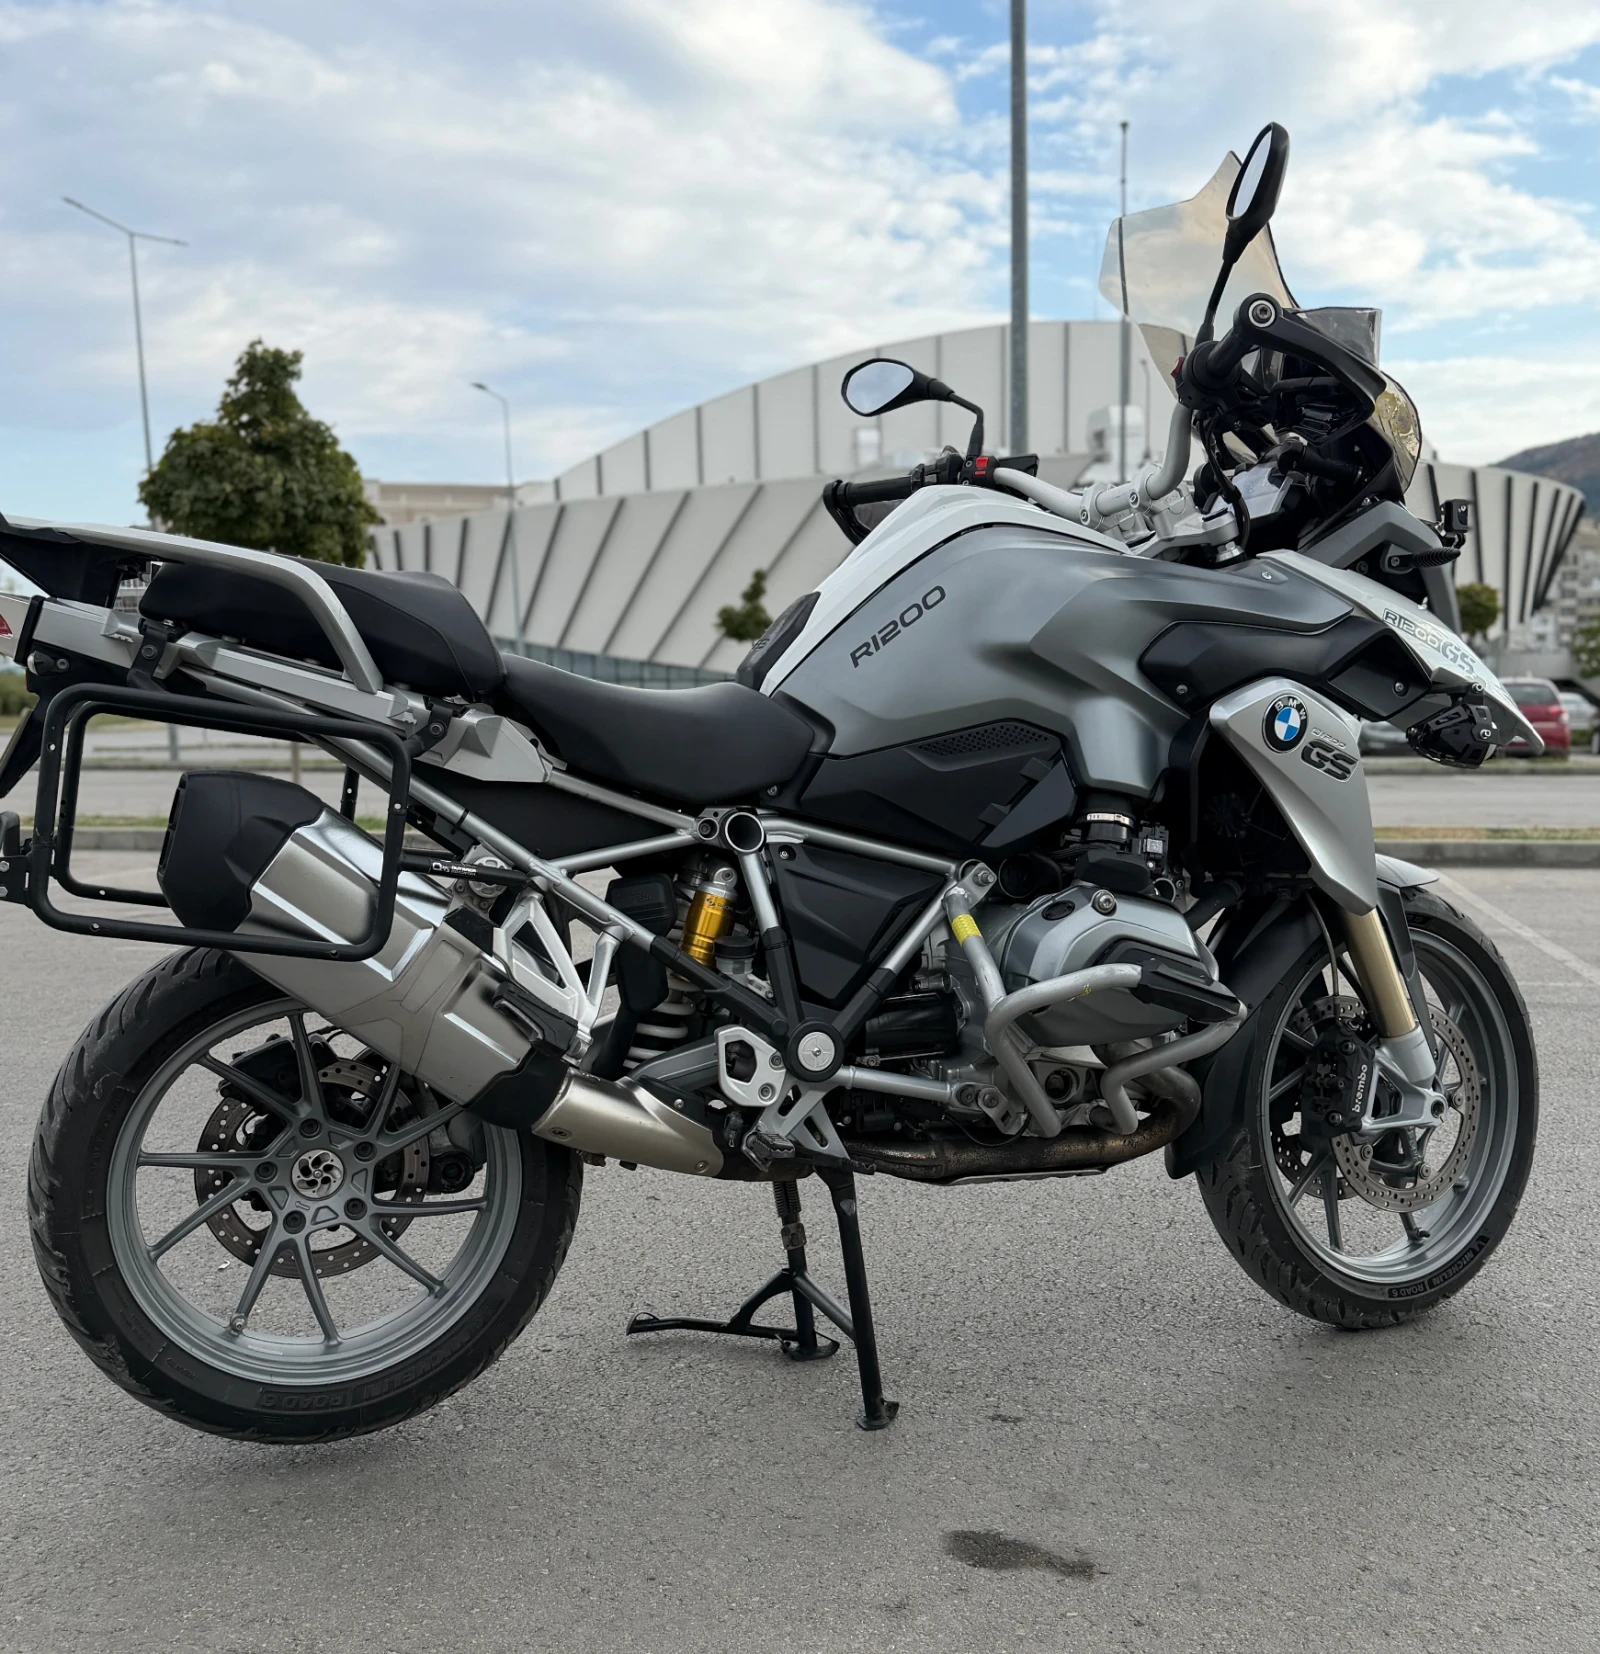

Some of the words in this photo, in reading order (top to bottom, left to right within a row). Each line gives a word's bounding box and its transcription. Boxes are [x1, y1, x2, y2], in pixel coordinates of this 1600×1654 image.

[849, 585, 946, 669] R1200
[1274, 697, 1307, 720] BMW
[1301, 740, 1357, 781] GS
[1351, 1064, 1368, 1113] brembo
[1433, 1248, 1475, 1286] MICHELIN
[1401, 1283, 1425, 1294] ROAD
